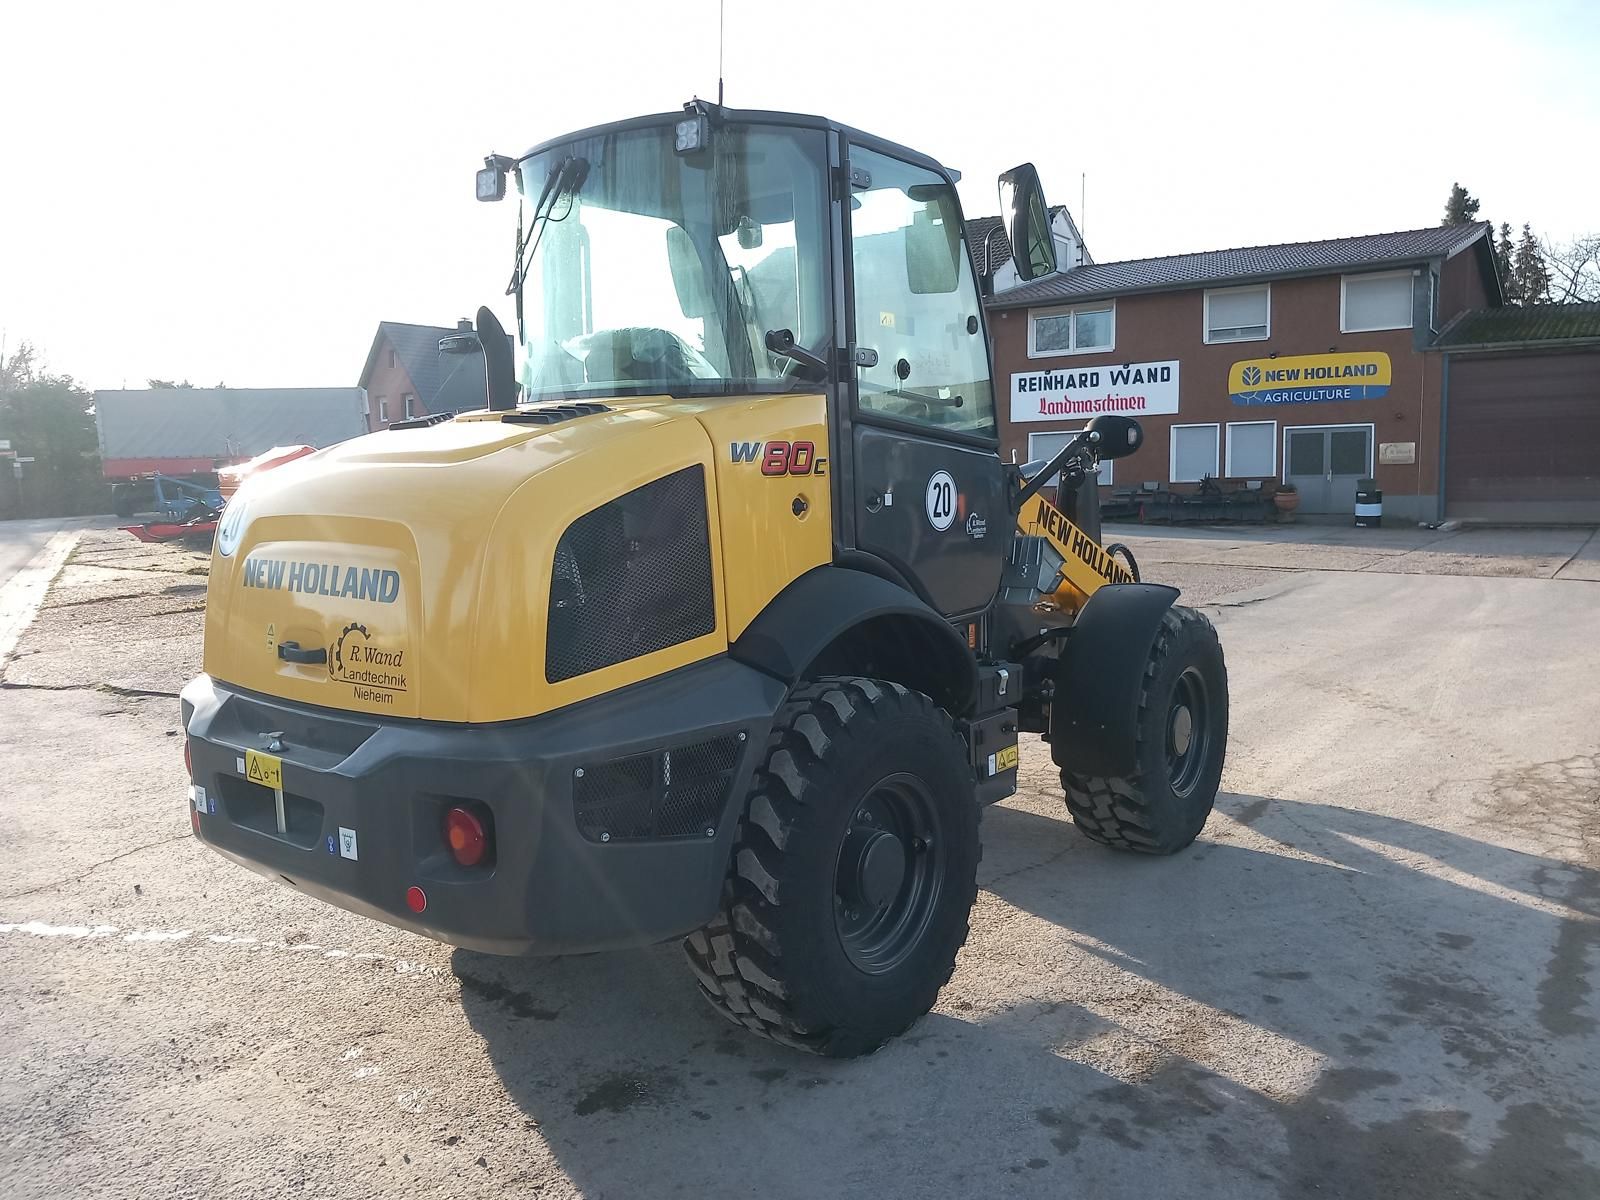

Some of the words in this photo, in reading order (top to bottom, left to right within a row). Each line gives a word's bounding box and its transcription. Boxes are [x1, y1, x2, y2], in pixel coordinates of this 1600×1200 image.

[1018, 371, 1100, 393] REINHARD
[1110, 366, 1171, 386] WAND
[1265, 369, 1300, 382] NEW
[1304, 363, 1378, 380] HOLLAND
[1037, 393, 1146, 416] Landmaschinen
[1263, 388, 1351, 403] AGRICULTURE
[933, 481, 951, 518] 20
[1036, 499, 1073, 547] NEW
[243, 558, 287, 590] NEW
[288, 561, 400, 604] HOLLAND
[343, 666, 407, 688] Landtechnik
[353, 686, 393, 704] Nieheim
